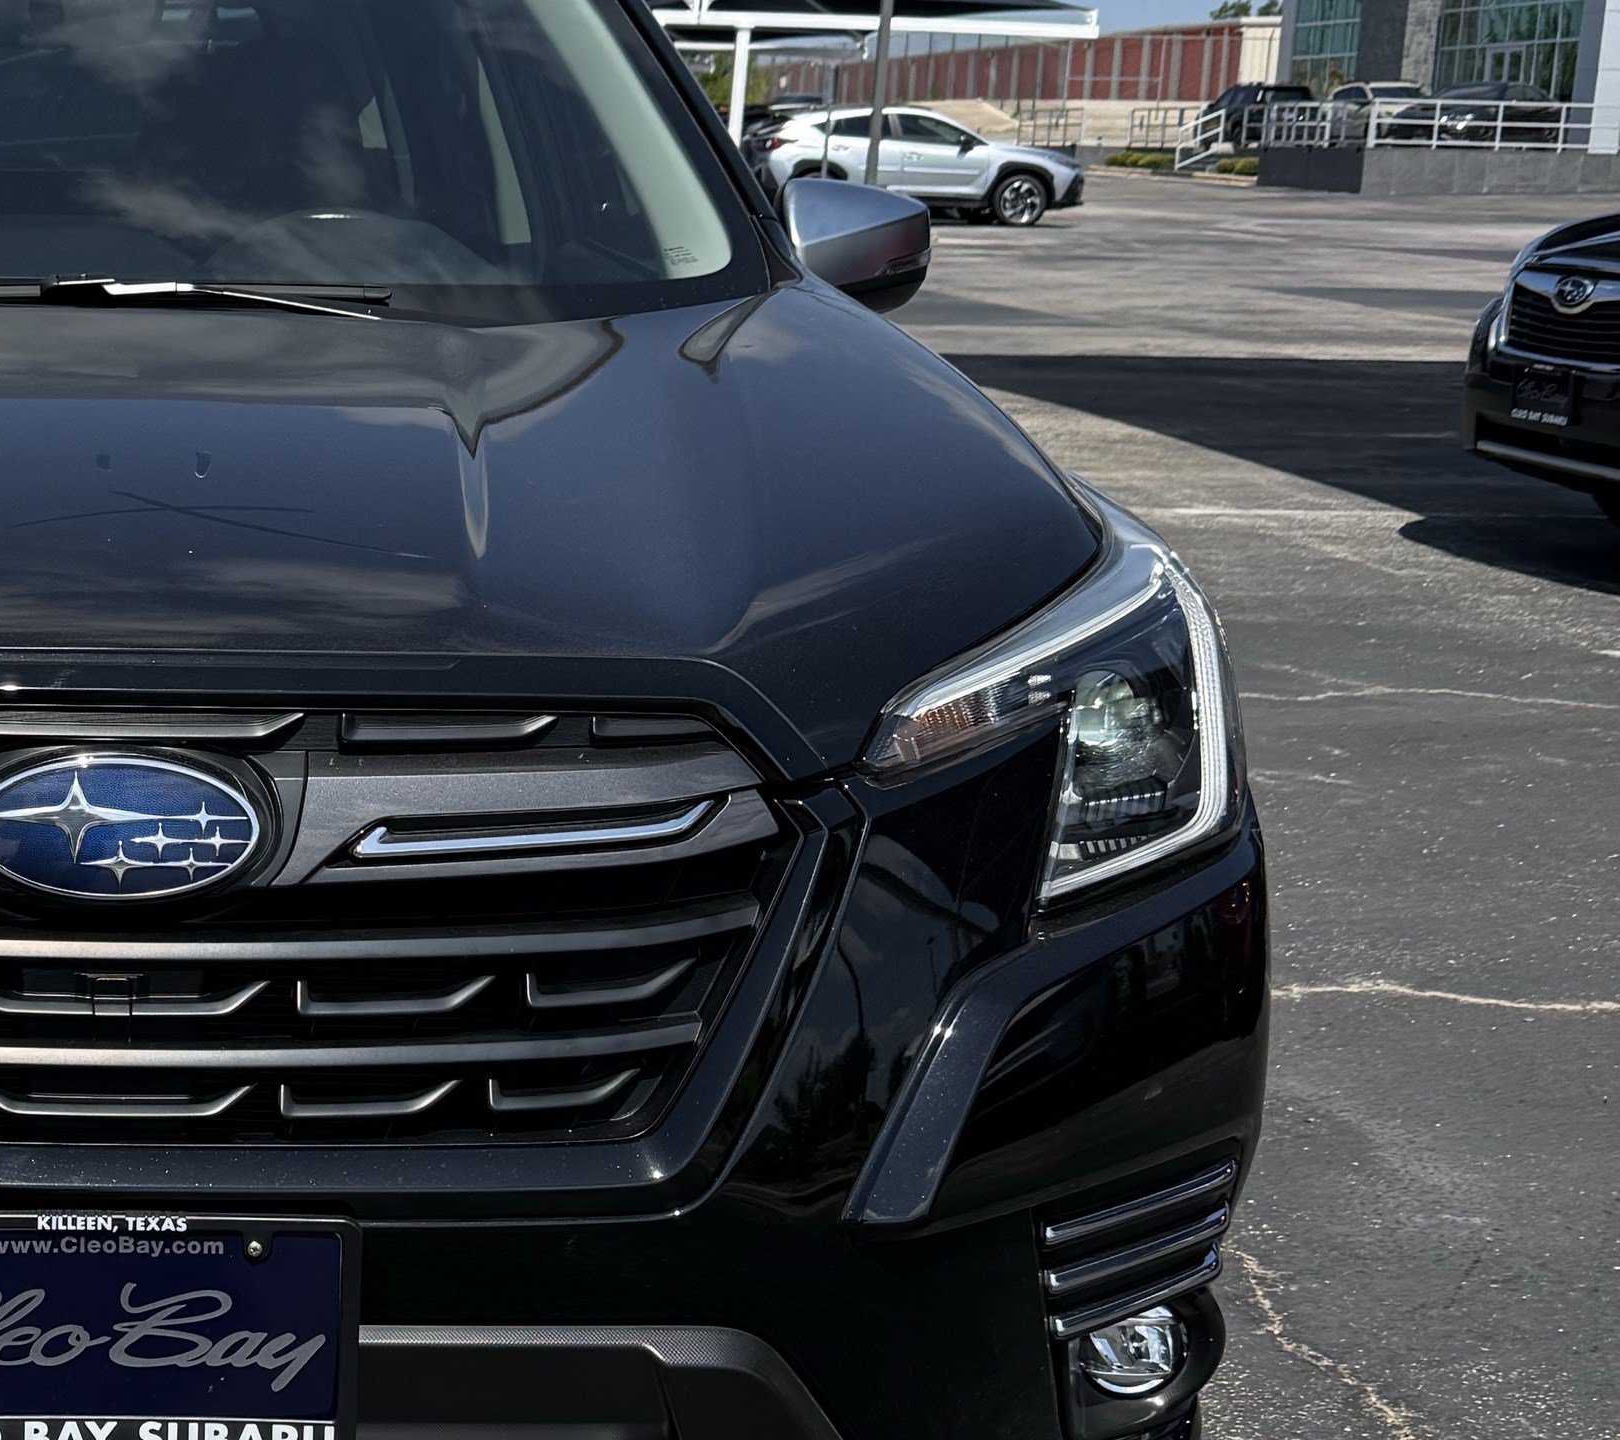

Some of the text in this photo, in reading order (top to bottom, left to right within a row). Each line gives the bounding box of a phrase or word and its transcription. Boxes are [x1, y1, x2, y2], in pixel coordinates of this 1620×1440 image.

[36, 1214, 188, 1233] KILLEEN, TEXAS
[108, 1282, 326, 1392] Bay
